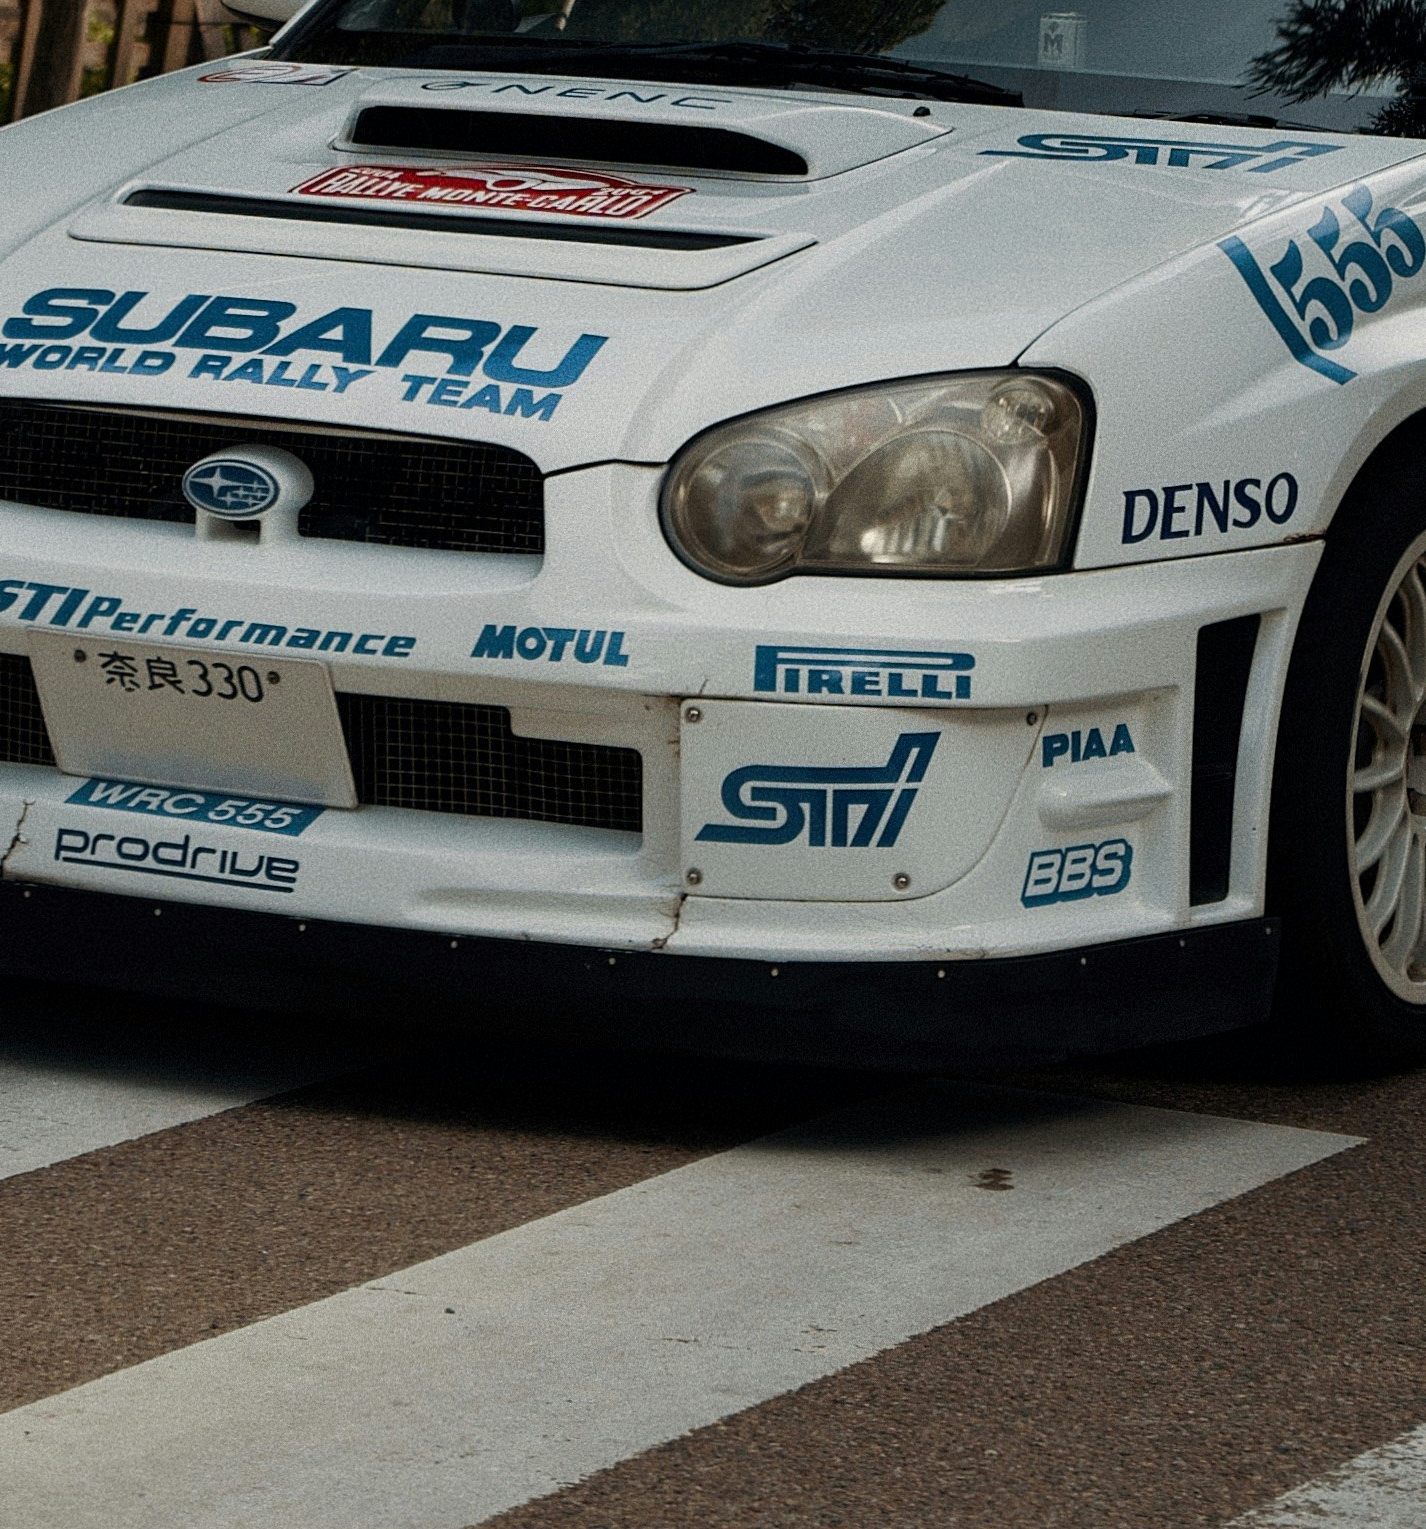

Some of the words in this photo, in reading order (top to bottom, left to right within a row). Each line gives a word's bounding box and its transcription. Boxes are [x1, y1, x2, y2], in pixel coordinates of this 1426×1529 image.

[319, 172, 424, 197] RALLYE
[418, 187, 654, 217] MONTE-CARLO
[1269, 184, 1426, 350] 555
[1, 287, 608, 388] SUBARU
[188, 354, 377, 393] RALLY
[401, 373, 562, 421] TEAM
[1122, 472, 1298, 544] DENSO
[471, 624, 629, 667] MOTUL
[754, 645, 975, 699] PIRELLI
[1042, 724, 1134, 767] PIAA
[86, 781, 204, 817] WRC
[207, 797, 304, 830] 555
[55, 828, 299, 884] prodrive
[1022, 838, 1132, 906] BBS
